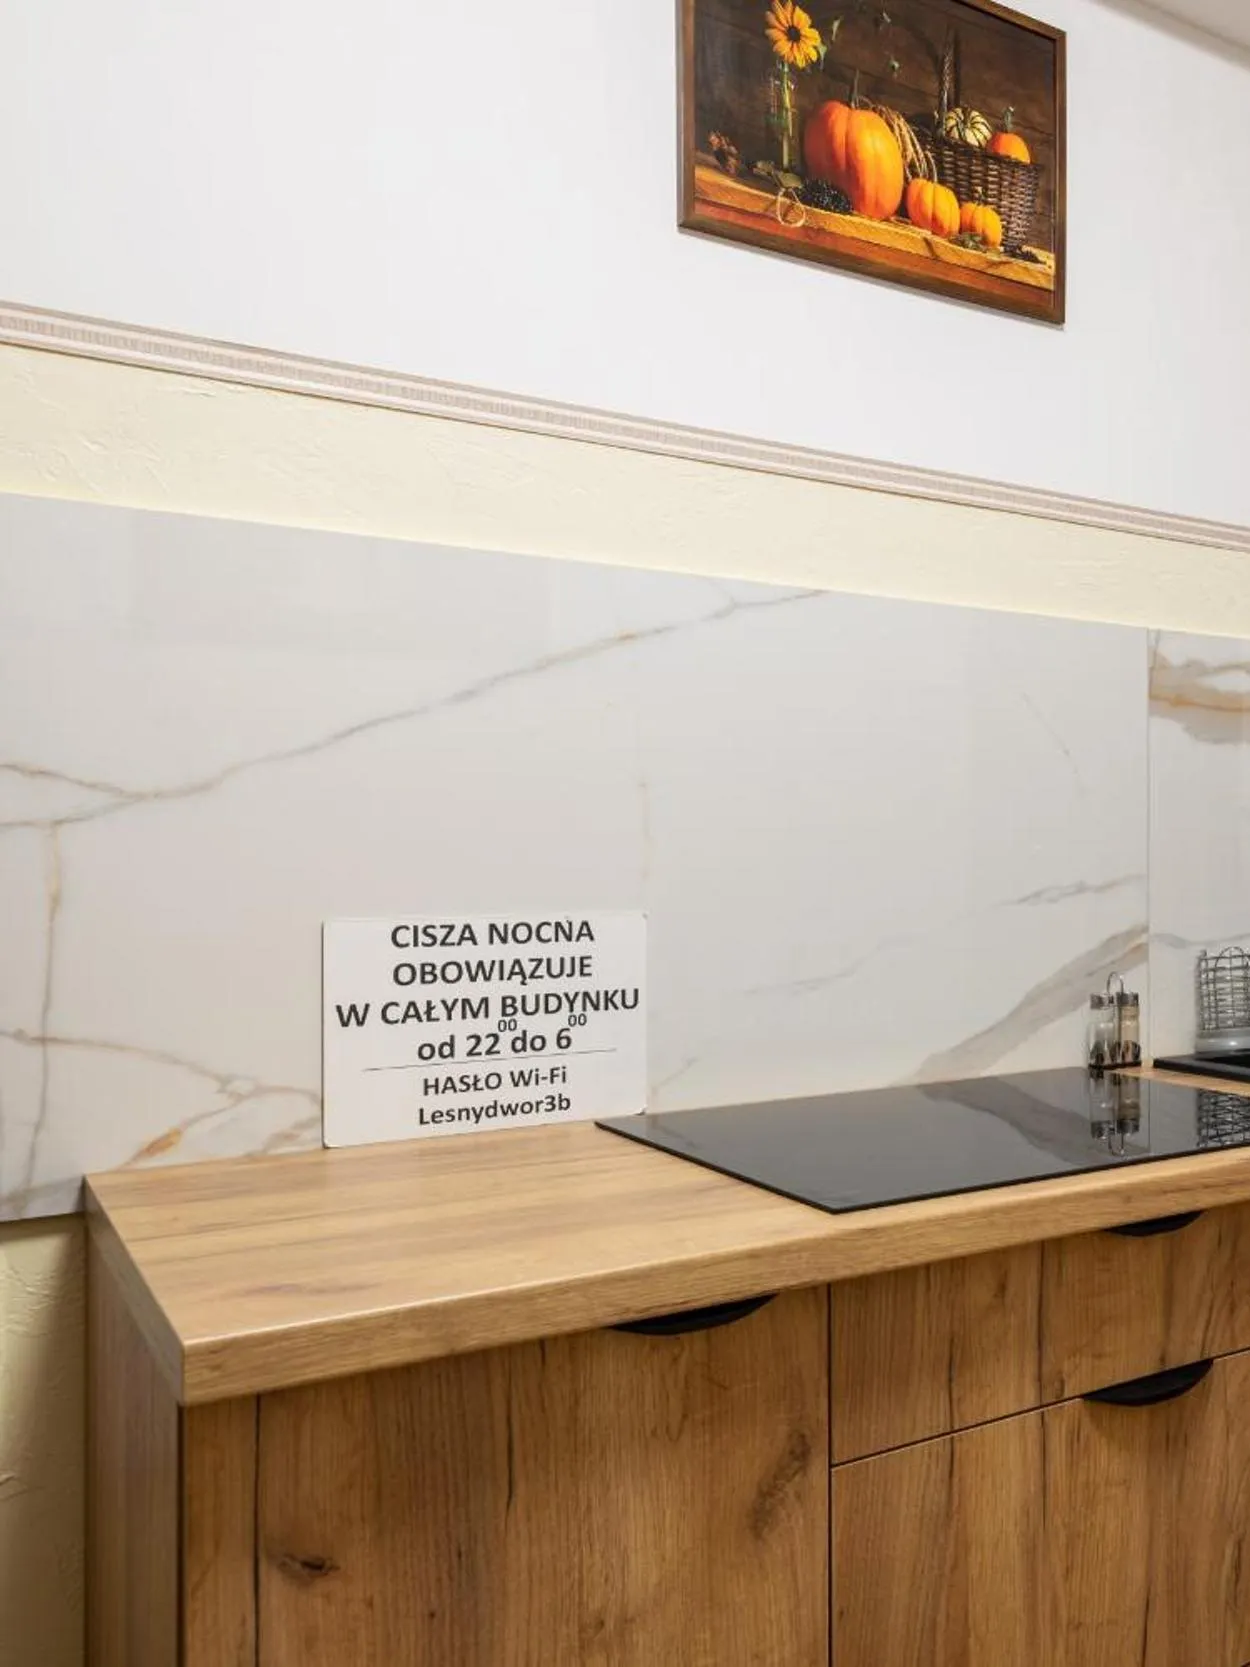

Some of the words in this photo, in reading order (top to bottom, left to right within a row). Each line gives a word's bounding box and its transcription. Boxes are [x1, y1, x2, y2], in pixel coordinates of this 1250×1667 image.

[391, 923, 478, 949] CISZA
[489, 920, 595, 945] NOCNA
[392, 955, 593, 986] OBOWIĄZUJE
[336, 1003, 370, 1028] W
[381, 997, 490, 1025] CAŁYM
[501, 988, 640, 1018] BUDYNKU
[417, 1035, 456, 1061] od
[511, 1029, 547, 1053] do
[423, 1071, 502, 1096] HASŁO
[509, 1066, 567, 1088] Wi-Fi
[419, 1093, 571, 1125] Lesnydwor3b
